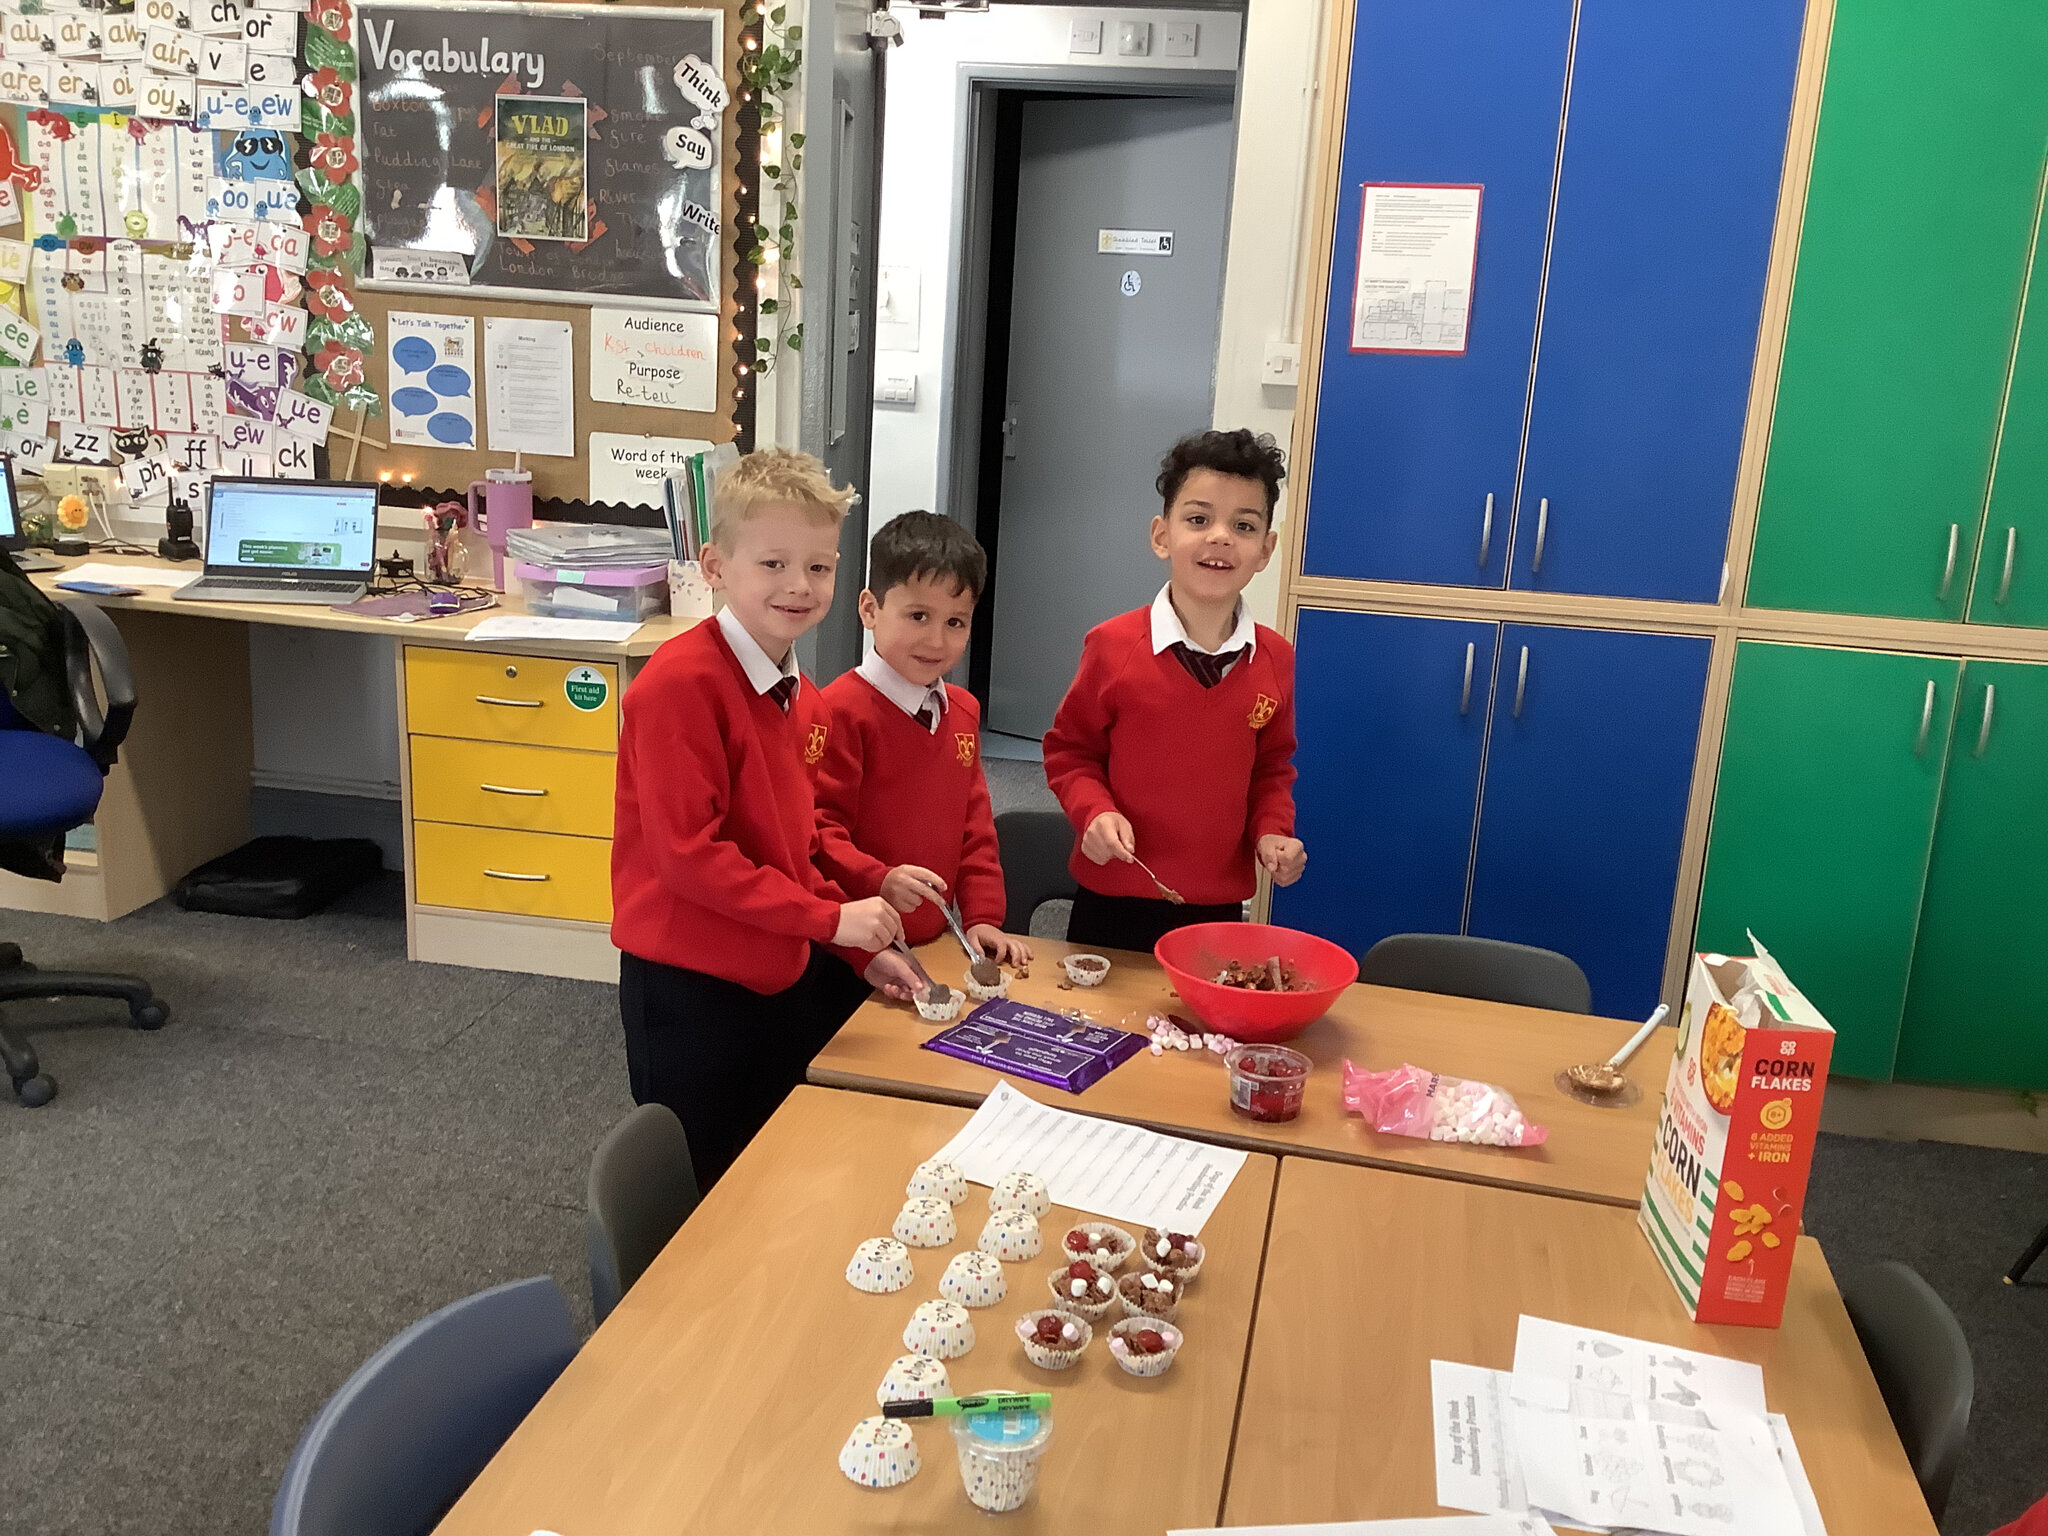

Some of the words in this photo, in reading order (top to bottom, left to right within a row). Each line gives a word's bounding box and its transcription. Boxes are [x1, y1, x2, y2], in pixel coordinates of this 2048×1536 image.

[147, 2, 173, 20] oo
[211, 0, 240, 22] ch
[11, 24, 41, 41] au
[61, 23, 86, 42] ar
[109, 25, 140, 43] aw
[246, 20, 272, 38] or
[152, 39, 190, 65] air
[209, 52, 221, 70] v
[363, 18, 545, 89] Vocabulary
[0, 71, 41, 92] are
[250, 63, 266, 81] e
[58, 75, 83, 93] er
[680, 62, 721, 108] Think
[147, 88, 175, 115] oy
[207, 97, 248, 115] u-e
[262, 96, 292, 116] ew
[511, 114, 569, 137] VLAD
[549, 145, 575, 153] LONDON
[675, 133, 706, 161] Say
[223, 190, 248, 209] oo
[267, 190, 297, 209] ue
[682, 202, 720, 235] Write
[397, 318, 415, 327] Let's
[416, 319, 432, 328] Talk
[434, 321, 466, 331] Together
[624, 316, 685, 333] Audience
[230, 351, 270, 370] u-e
[629, 362, 681, 382] Purpose
[15, 376, 38, 397] ie
[291, 399, 321, 424] ue
[74, 433, 99, 452] zz
[233, 425, 265, 445] ew
[20, 439, 43, 458] or
[184, 439, 207, 470] ff
[278, 441, 307, 468] ck
[610, 447, 648, 462] Word
[651, 450, 666, 464] of
[138, 459, 167, 491] ph
[635, 467, 668, 479] week
[571, 684, 587, 693] First
[588, 686, 600, 695] aid
[574, 693, 583, 701] kit
[583, 694, 598, 702] here
[1754, 1058, 1816, 1078] CORN
[1751, 1076, 1812, 1092] FLAKES
[1749, 1141, 1792, 1152] VITAMINS
[1760, 1133, 1794, 1143] ADDED
[1663, 1113, 1701, 1198] CORN
[1758, 1151, 1791, 1163] IRON
[1656, 1150, 1695, 1225] FLAKES
